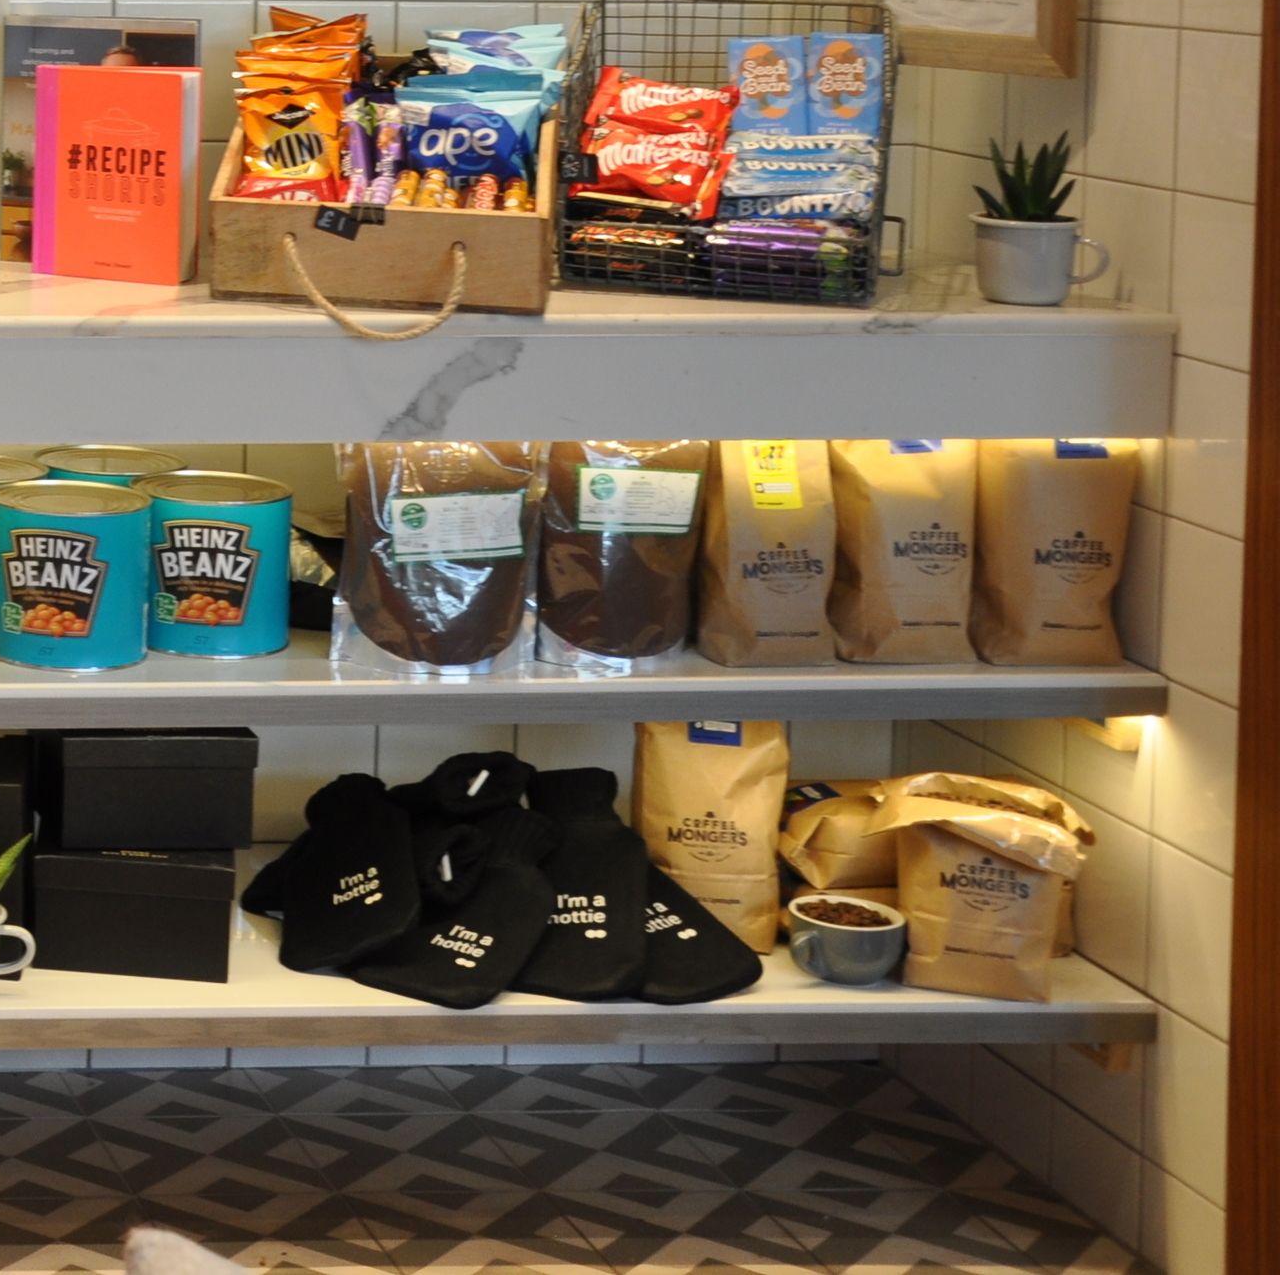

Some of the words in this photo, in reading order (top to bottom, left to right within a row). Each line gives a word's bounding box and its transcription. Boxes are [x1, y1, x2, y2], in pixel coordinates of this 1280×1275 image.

[264, 133, 324, 171] MINI
[419, 127, 499, 165] ape
[67, 143, 167, 178] #RECIPE
[598, 143, 711, 175] Maltesers
[738, 196, 844, 217] BOUNTY
[173, 528, 240, 550] HEINZ
[910, 531, 960, 542] COFFEE
[1051, 539, 1105, 551] COFFEE
[20, 536, 86, 562] HEINZ
[758, 549, 809, 561] COFFEE
[8, 560, 98, 595] BEANZ
[160, 551, 252, 583] BEANZ
[682, 818, 737, 830] COFFEE
[340, 873, 365, 890] I'm
[367, 867, 378, 878] a
[958, 863, 1018, 880] COFFEE
[333, 879, 380, 905] hottie
[557, 894, 588, 908] I'm
[592, 895, 606, 907] a
[645, 915, 682, 933] ottie
[430, 933, 485, 958] hottie
[449, 925, 479, 942] I'm
[479, 935, 494, 946] a
